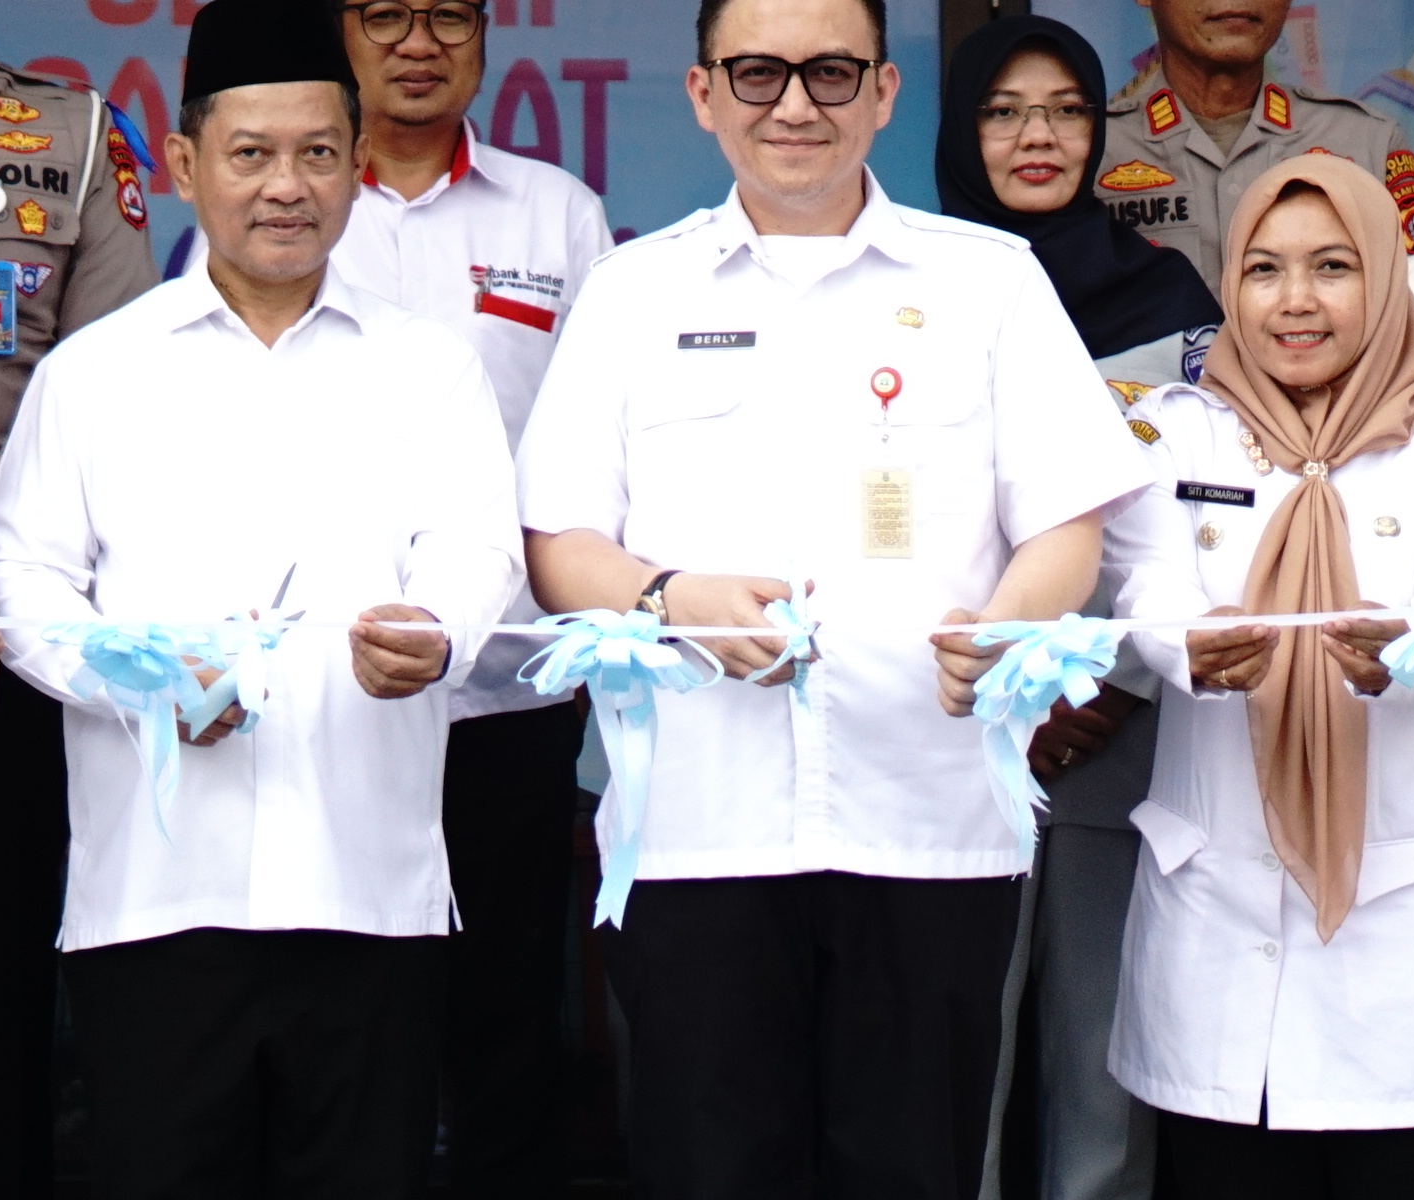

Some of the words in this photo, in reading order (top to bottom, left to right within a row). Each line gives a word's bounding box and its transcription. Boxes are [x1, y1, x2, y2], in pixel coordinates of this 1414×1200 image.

[1108, 196, 1189, 227] USUF.E
[491, 267, 522, 280] bank
[526, 269, 565, 289] banten
[694, 334, 738, 345] BERLY
[1130, 420, 1159, 442] NDAGRI
[1187, 486, 1203, 496] SITI
[1204, 488, 1245, 501] KOMARIAH
